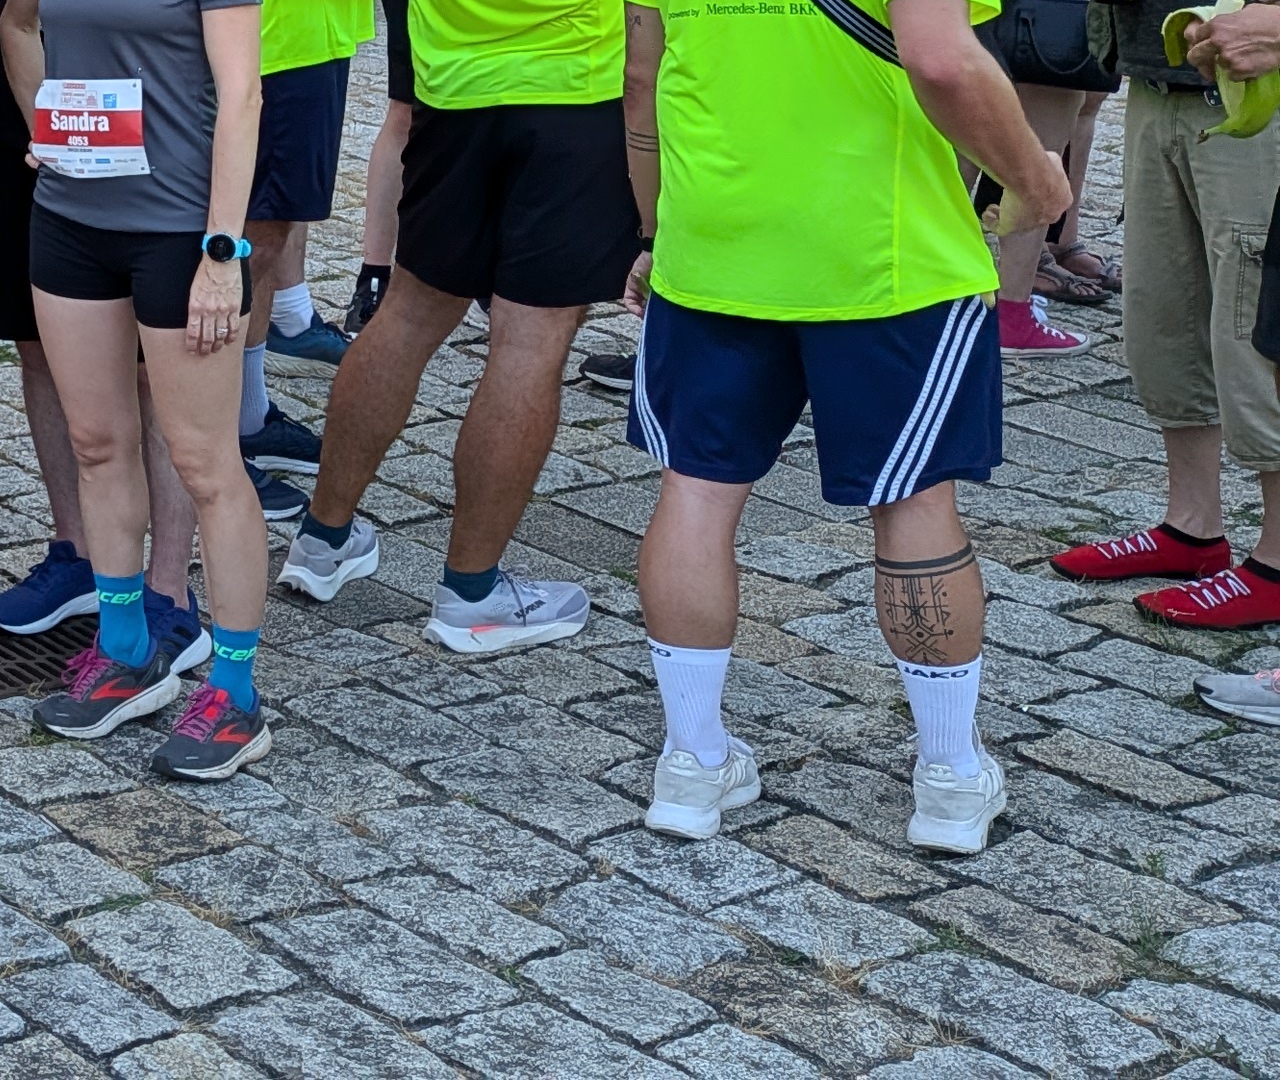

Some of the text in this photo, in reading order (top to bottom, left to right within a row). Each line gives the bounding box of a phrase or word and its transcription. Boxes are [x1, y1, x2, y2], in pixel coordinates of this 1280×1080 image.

[706, 2, 785, 15] Mercedes-Benz
[789, 3, 818, 16] BKK
[50, 110, 110, 132] Sandra
[67, 135, 88, 146] 4053
[100, 590, 143, 605] cep
[217, 646, 257, 662] cep
